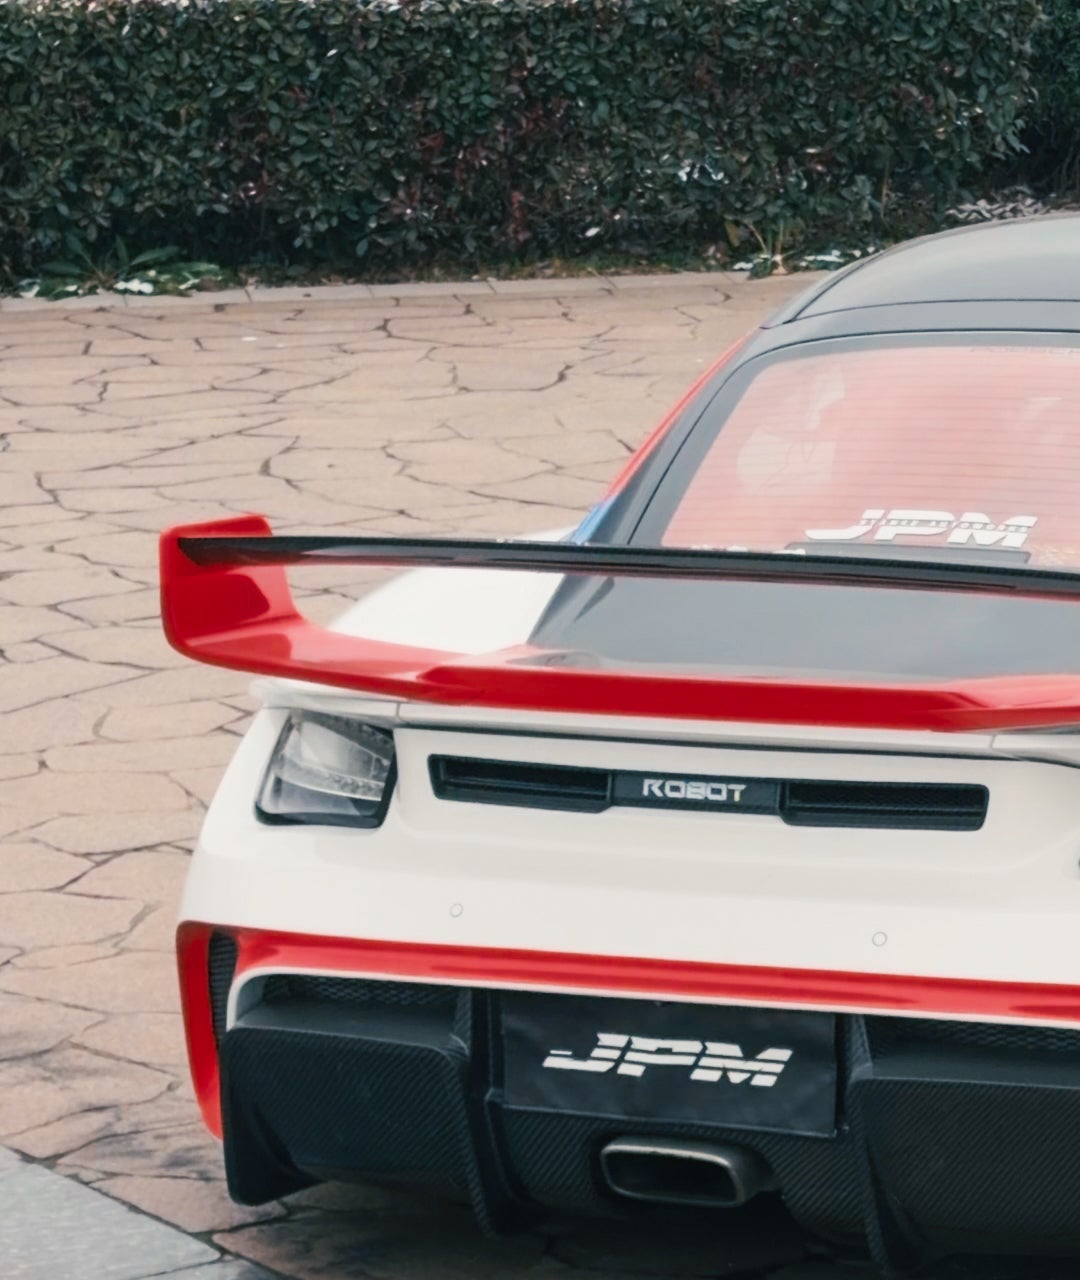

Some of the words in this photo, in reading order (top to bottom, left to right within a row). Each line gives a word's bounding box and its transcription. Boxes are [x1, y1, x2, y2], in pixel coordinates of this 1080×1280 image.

[805, 509, 1038, 547] JPM
[642, 778, 747, 802] ROBOT
[543, 1032, 794, 1087] JPM
